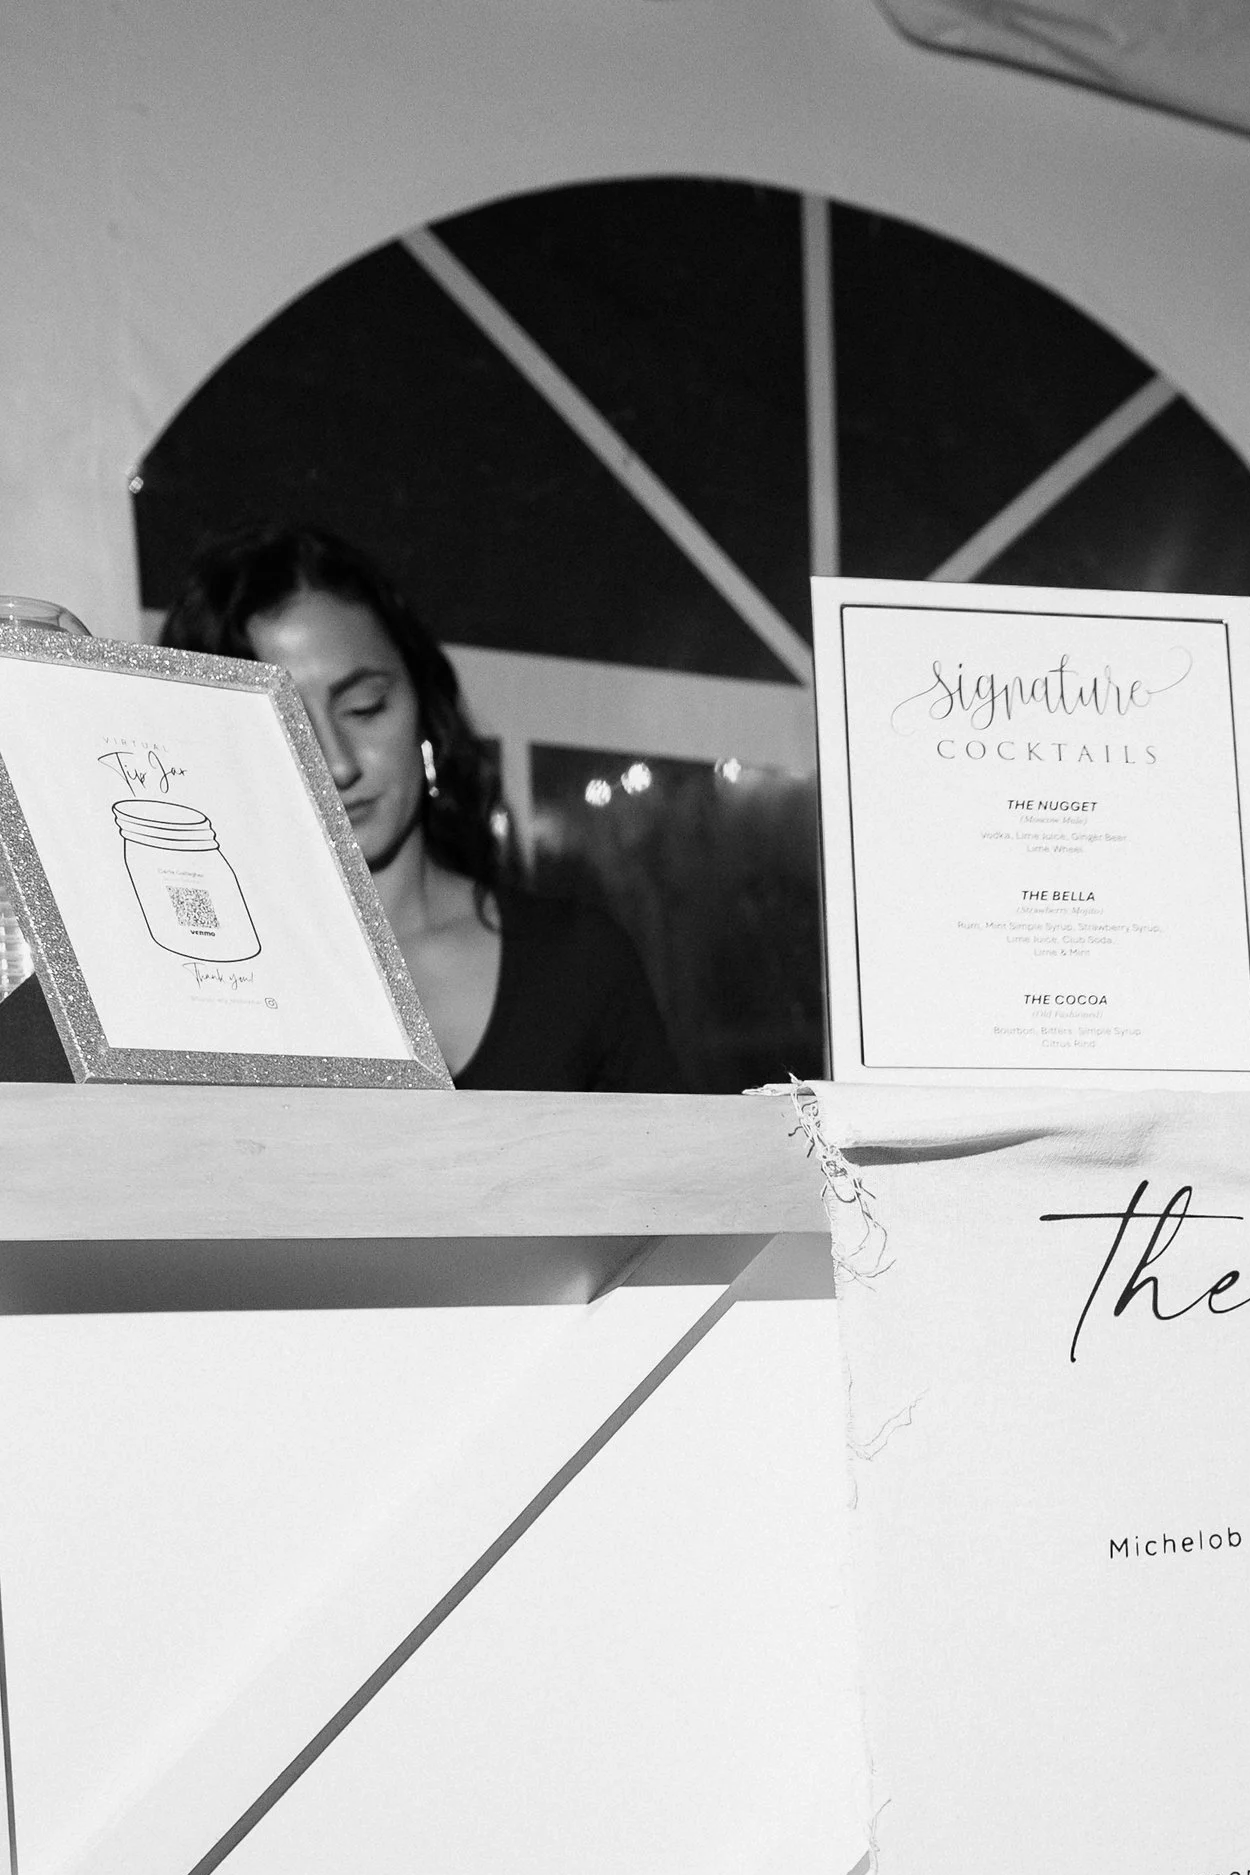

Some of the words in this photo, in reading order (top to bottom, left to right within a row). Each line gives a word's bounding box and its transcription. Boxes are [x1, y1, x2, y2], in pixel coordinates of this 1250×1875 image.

[891, 645, 1194, 737] signature
[936, 738, 1159, 766] COCKTAILS
[98, 752, 146, 797] Tip
[148, 751, 187, 793] Jar
[1007, 799, 1034, 810] THE
[1037, 801, 1097, 812] NUGGET
[1022, 891, 1048, 900] THE
[1052, 891, 1095, 902] BELLA
[182, 962, 225, 988] Thank
[1024, 995, 1050, 1005] THE
[1055, 995, 1108, 1005] COCOA
[1109, 1526, 1242, 1560] Michelob
